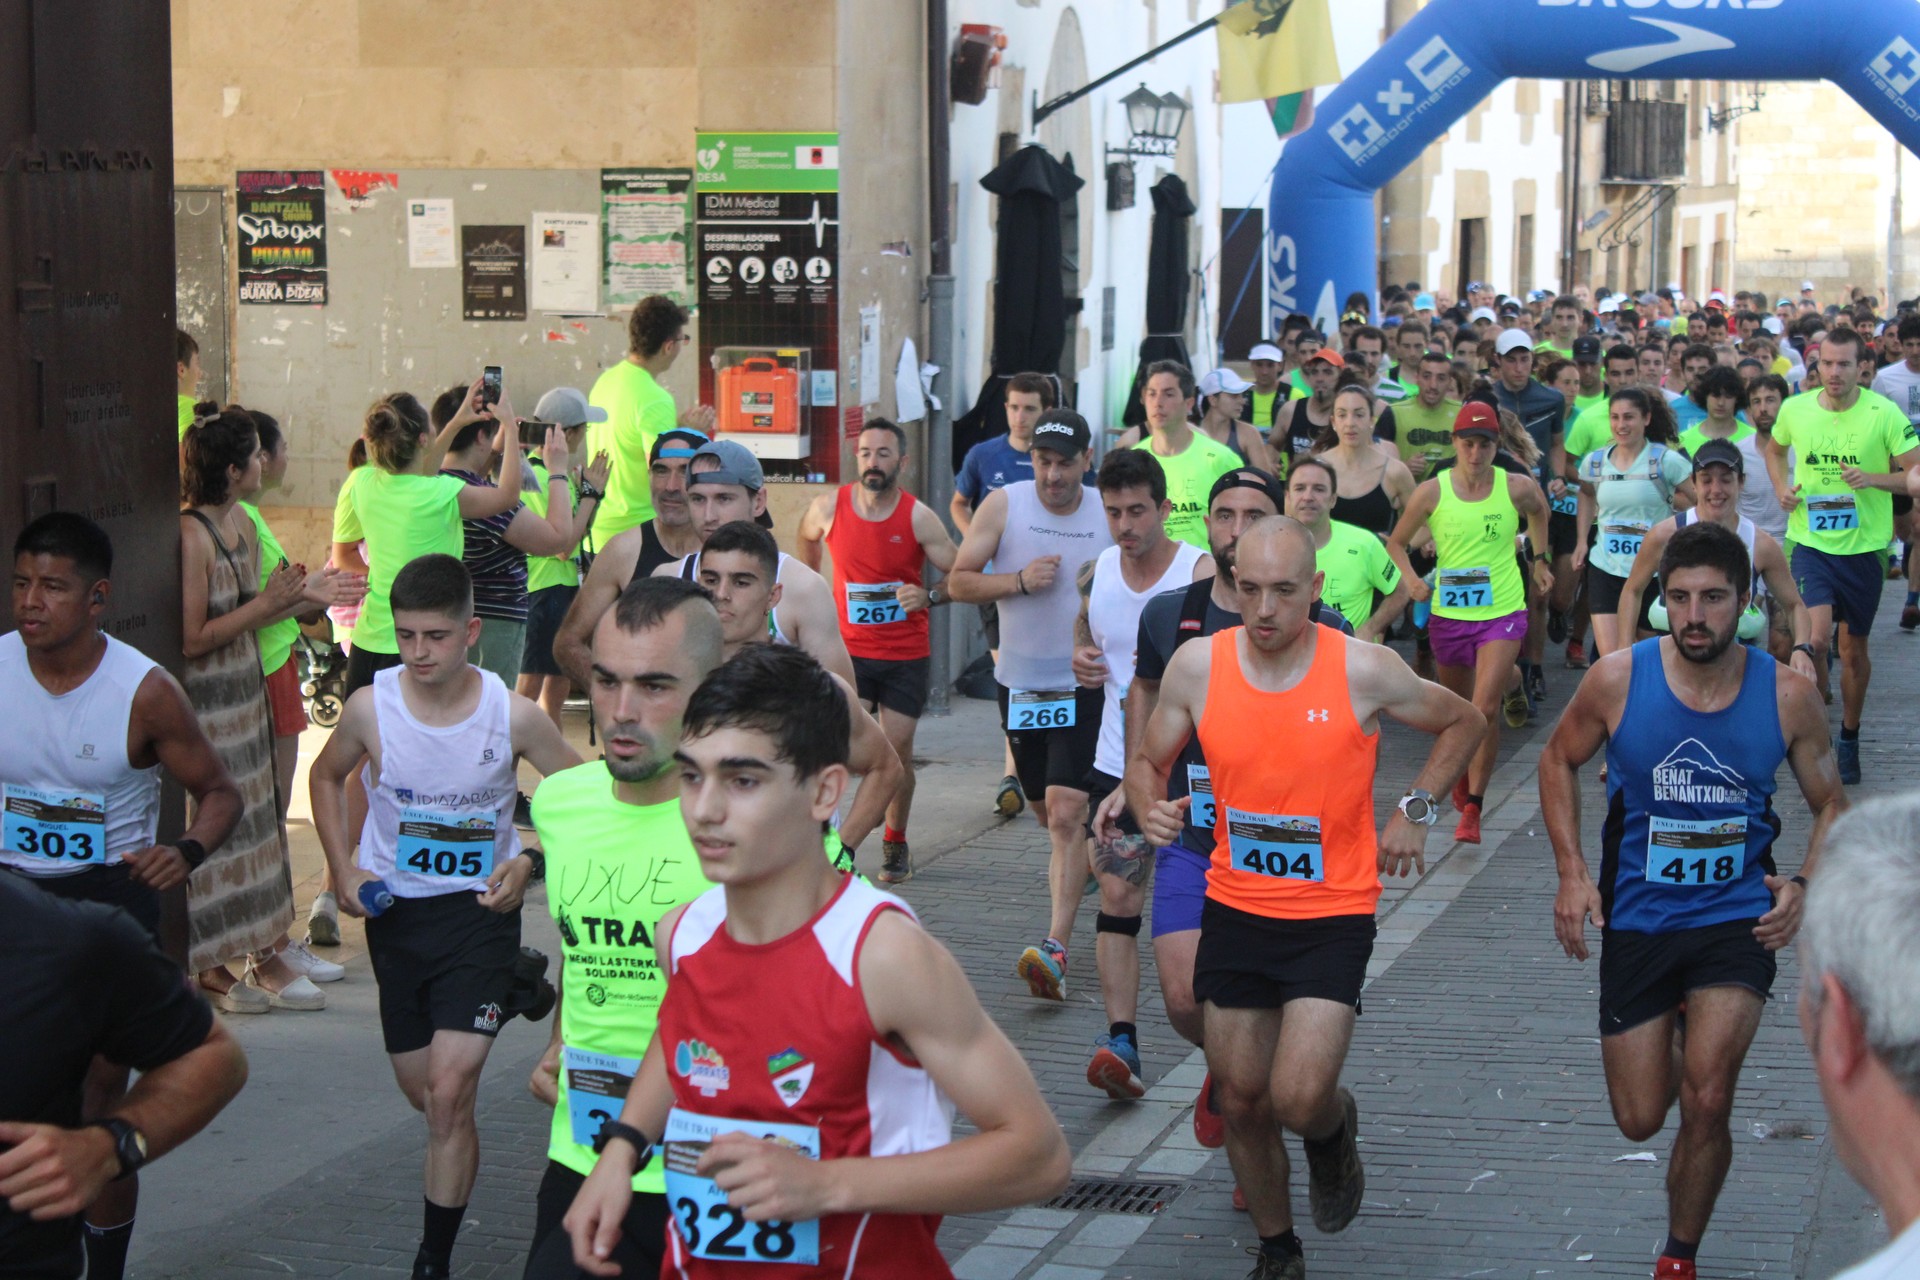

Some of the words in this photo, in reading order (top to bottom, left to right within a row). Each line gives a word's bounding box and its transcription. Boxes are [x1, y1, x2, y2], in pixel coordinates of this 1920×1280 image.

[697, 173, 727, 183] DESA
[705, 196, 733, 208] IDM
[735, 195, 780, 209] Medical
[704, 243, 765, 251] DESFIBRILADOR
[1035, 421, 1074, 436] adidas
[1821, 454, 1861, 465] TRAIL
[1171, 502, 1203, 513] RAIL
[1815, 514, 1853, 531] 277
[1028, 526, 1095, 539] NORTHWAVE
[1609, 539, 1642, 555] 360
[1445, 589, 1485, 607] 217
[856, 604, 899, 623] 267
[1019, 707, 1069, 728] 266
[1653, 765, 1694, 785] BEÑAT
[417, 788, 498, 807] IDIAZABAL
[1653, 784, 1725, 803] BENANTXIO
[1203, 803, 1218, 827] 3
[1248, 815, 1268, 823] TRAIL
[38, 822, 68, 831] MIGUEL
[16, 826, 94, 860] 303
[407, 847, 483, 877] 405
[1243, 848, 1315, 879] 404
[1660, 855, 1735, 883] 418
[559, 857, 682, 915] UXUE
[581, 916, 657, 949] TRA
[585, 968, 656, 981] SOLIDARIOA
[588, 1109, 615, 1155] 3
[676, 1196, 796, 1260] 328
